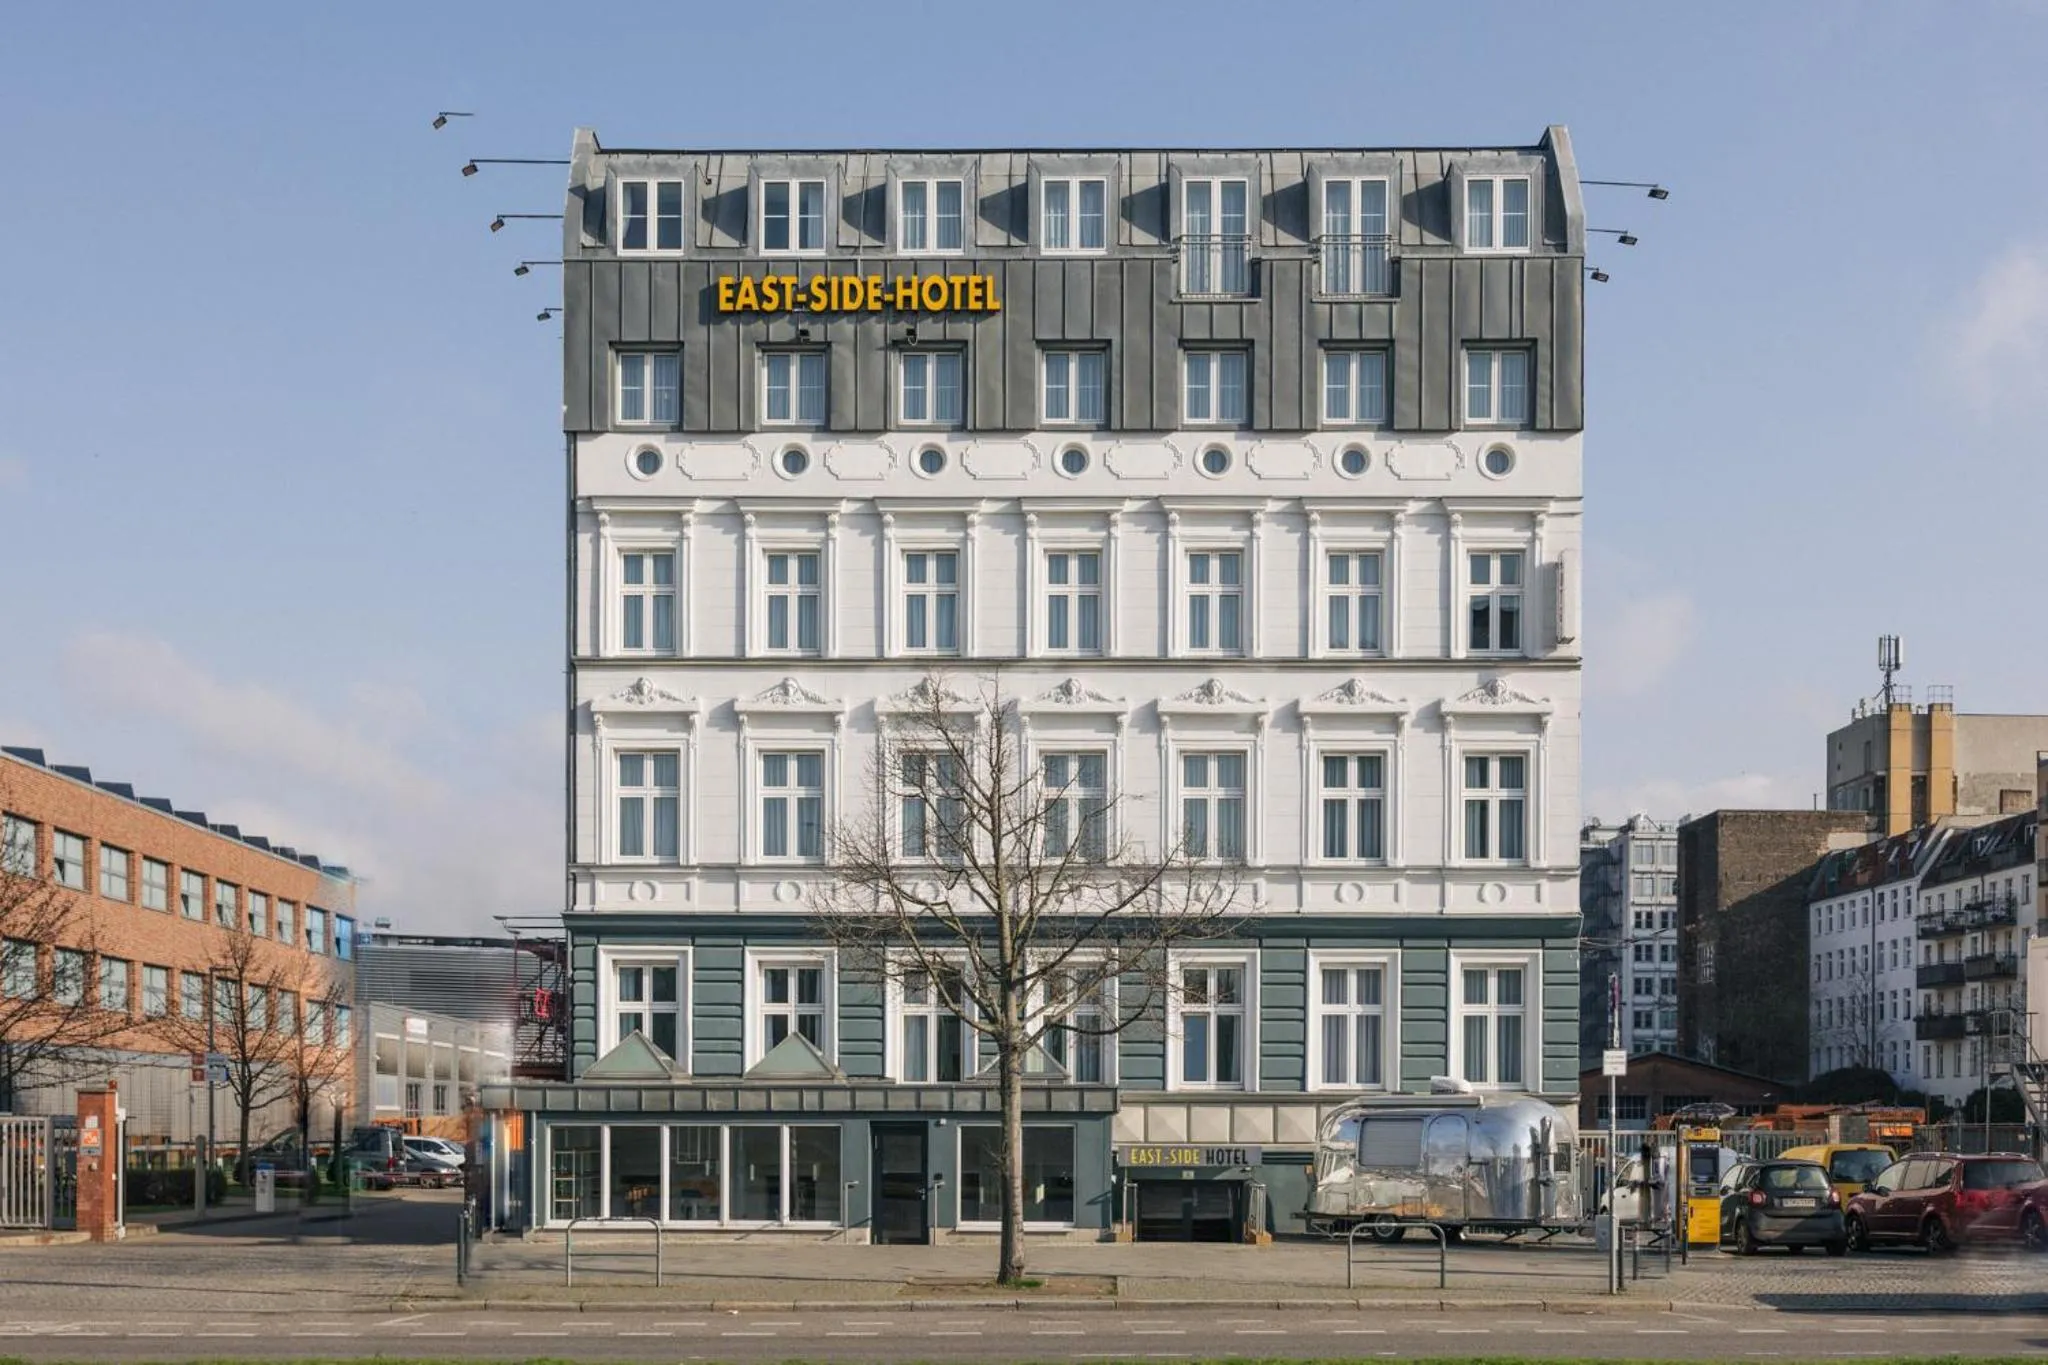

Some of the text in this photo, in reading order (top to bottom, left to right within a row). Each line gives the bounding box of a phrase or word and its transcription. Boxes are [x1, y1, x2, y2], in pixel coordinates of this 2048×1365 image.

[719, 275, 1001, 311] EAST-SIDE-HOTEL
[1130, 1147, 1249, 1165] EAST-SIDE HOTEL
